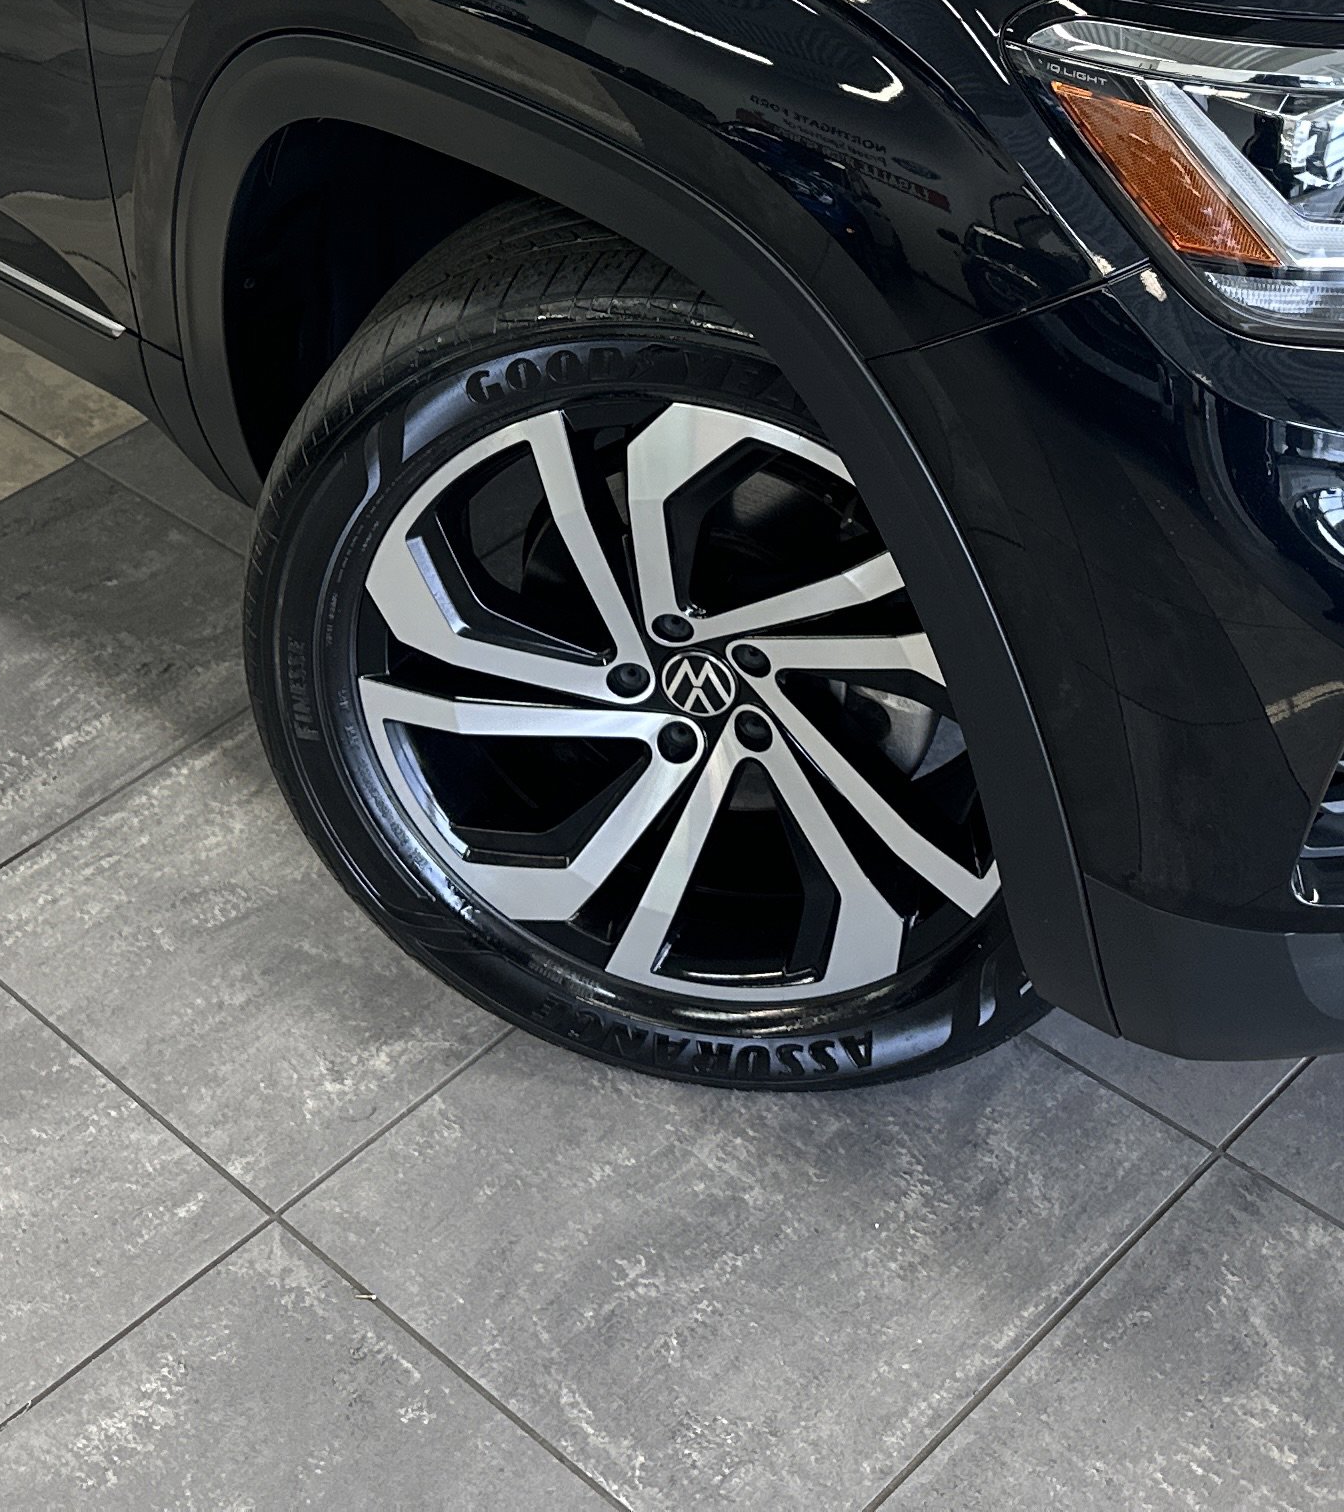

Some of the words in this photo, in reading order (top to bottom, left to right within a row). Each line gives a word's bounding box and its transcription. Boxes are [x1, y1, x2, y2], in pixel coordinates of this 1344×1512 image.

[465, 343, 808, 405] GOODYEA
[287, 636, 320, 740] FINESSE
[531, 992, 873, 1077] ASSURANCE
